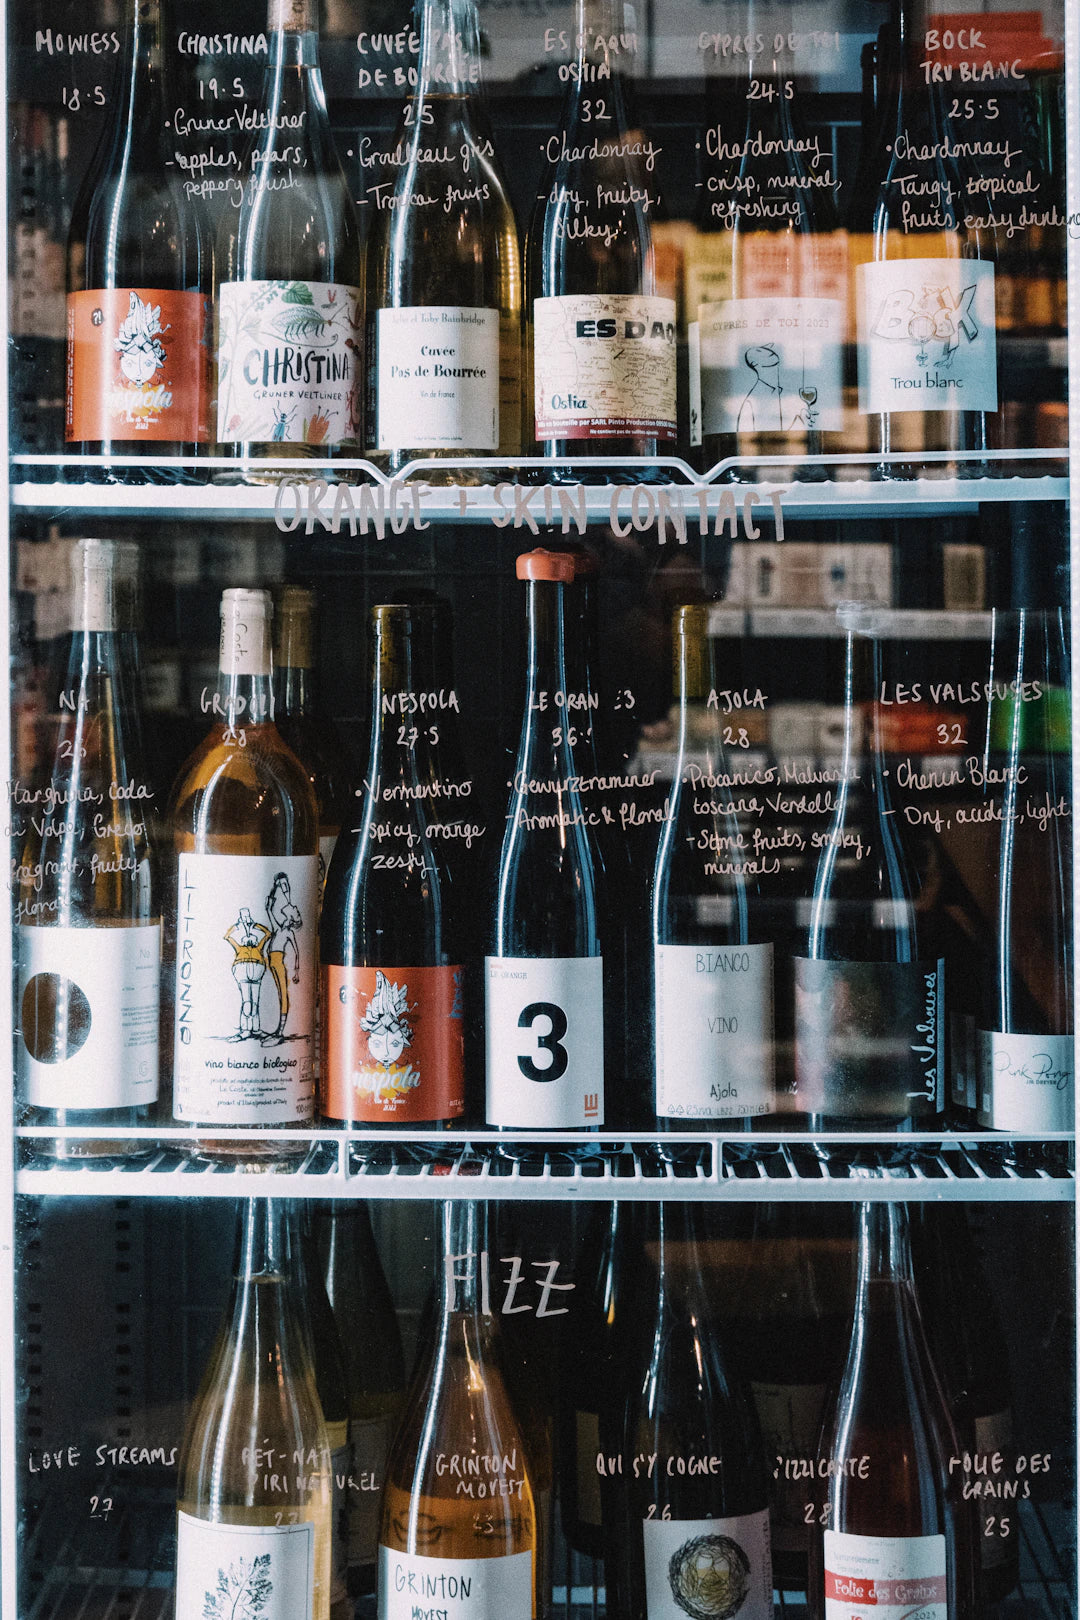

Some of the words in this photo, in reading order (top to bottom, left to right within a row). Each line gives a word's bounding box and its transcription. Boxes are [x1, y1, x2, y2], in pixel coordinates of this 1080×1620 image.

[177, 32, 268, 55] CHRISTINA
[543, 28, 568, 52] ES
[924, 28, 986, 49] BOCK
[358, 66, 388, 88] DE
[558, 62, 610, 82] OSTIA
[958, 59, 1026, 82] BLANC
[402, 104, 435, 127] 25
[581, 99, 613, 123] 32
[546, 130, 663, 172] Chardonnay
[705, 124, 835, 168] Chardonnay
[893, 130, 1024, 167] Chardonnay
[576, 318, 617, 338] ES
[756, 317, 770, 328] DE
[779, 317, 799, 328] TOI
[420, 345, 456, 357] Cuvée
[391, 365, 411, 378] Pas
[414, 365, 429, 378] de
[433, 363, 486, 379] Bourrée
[890, 376, 921, 389] Trou
[925, 371, 964, 389] blanc
[551, 393, 588, 412] Ostia
[274, 476, 431, 540] ORANGE
[491, 484, 588, 536] SKIN
[608, 484, 787, 545] CONTACT
[381, 689, 461, 714] NESPOLA
[879, 680, 922, 706] LES
[928, 679, 1044, 703] VALSEUSES
[722, 726, 751, 749] 28
[936, 722, 970, 746] 32
[965, 754, 1029, 787] Blanc
[363, 775, 474, 802] Vermentino
[424, 819, 487, 849] orange
[13, 897, 74, 926] flora
[695, 953, 750, 974] BIANCO
[707, 1016, 739, 1034] VINO
[517, 1001, 569, 1083] 3
[226, 1057, 260, 1070] bianco
[262, 1056, 298, 1073] biologico
[709, 1082, 738, 1102] Ajola
[443, 1250, 577, 1318] FIZZ
[28, 1447, 81, 1473] LOVE
[95, 1444, 179, 1466] STREAMS
[436, 1448, 518, 1478] GRINTON
[595, 1452, 624, 1476] QUI
[666, 1455, 723, 1477] COGNE
[1015, 1452, 1052, 1474] DES
[962, 1479, 1031, 1501] GRAINS
[983, 1515, 1011, 1538] 25
[395, 1564, 472, 1601] GRINTON
[834, 1579, 865, 1598] Folie
